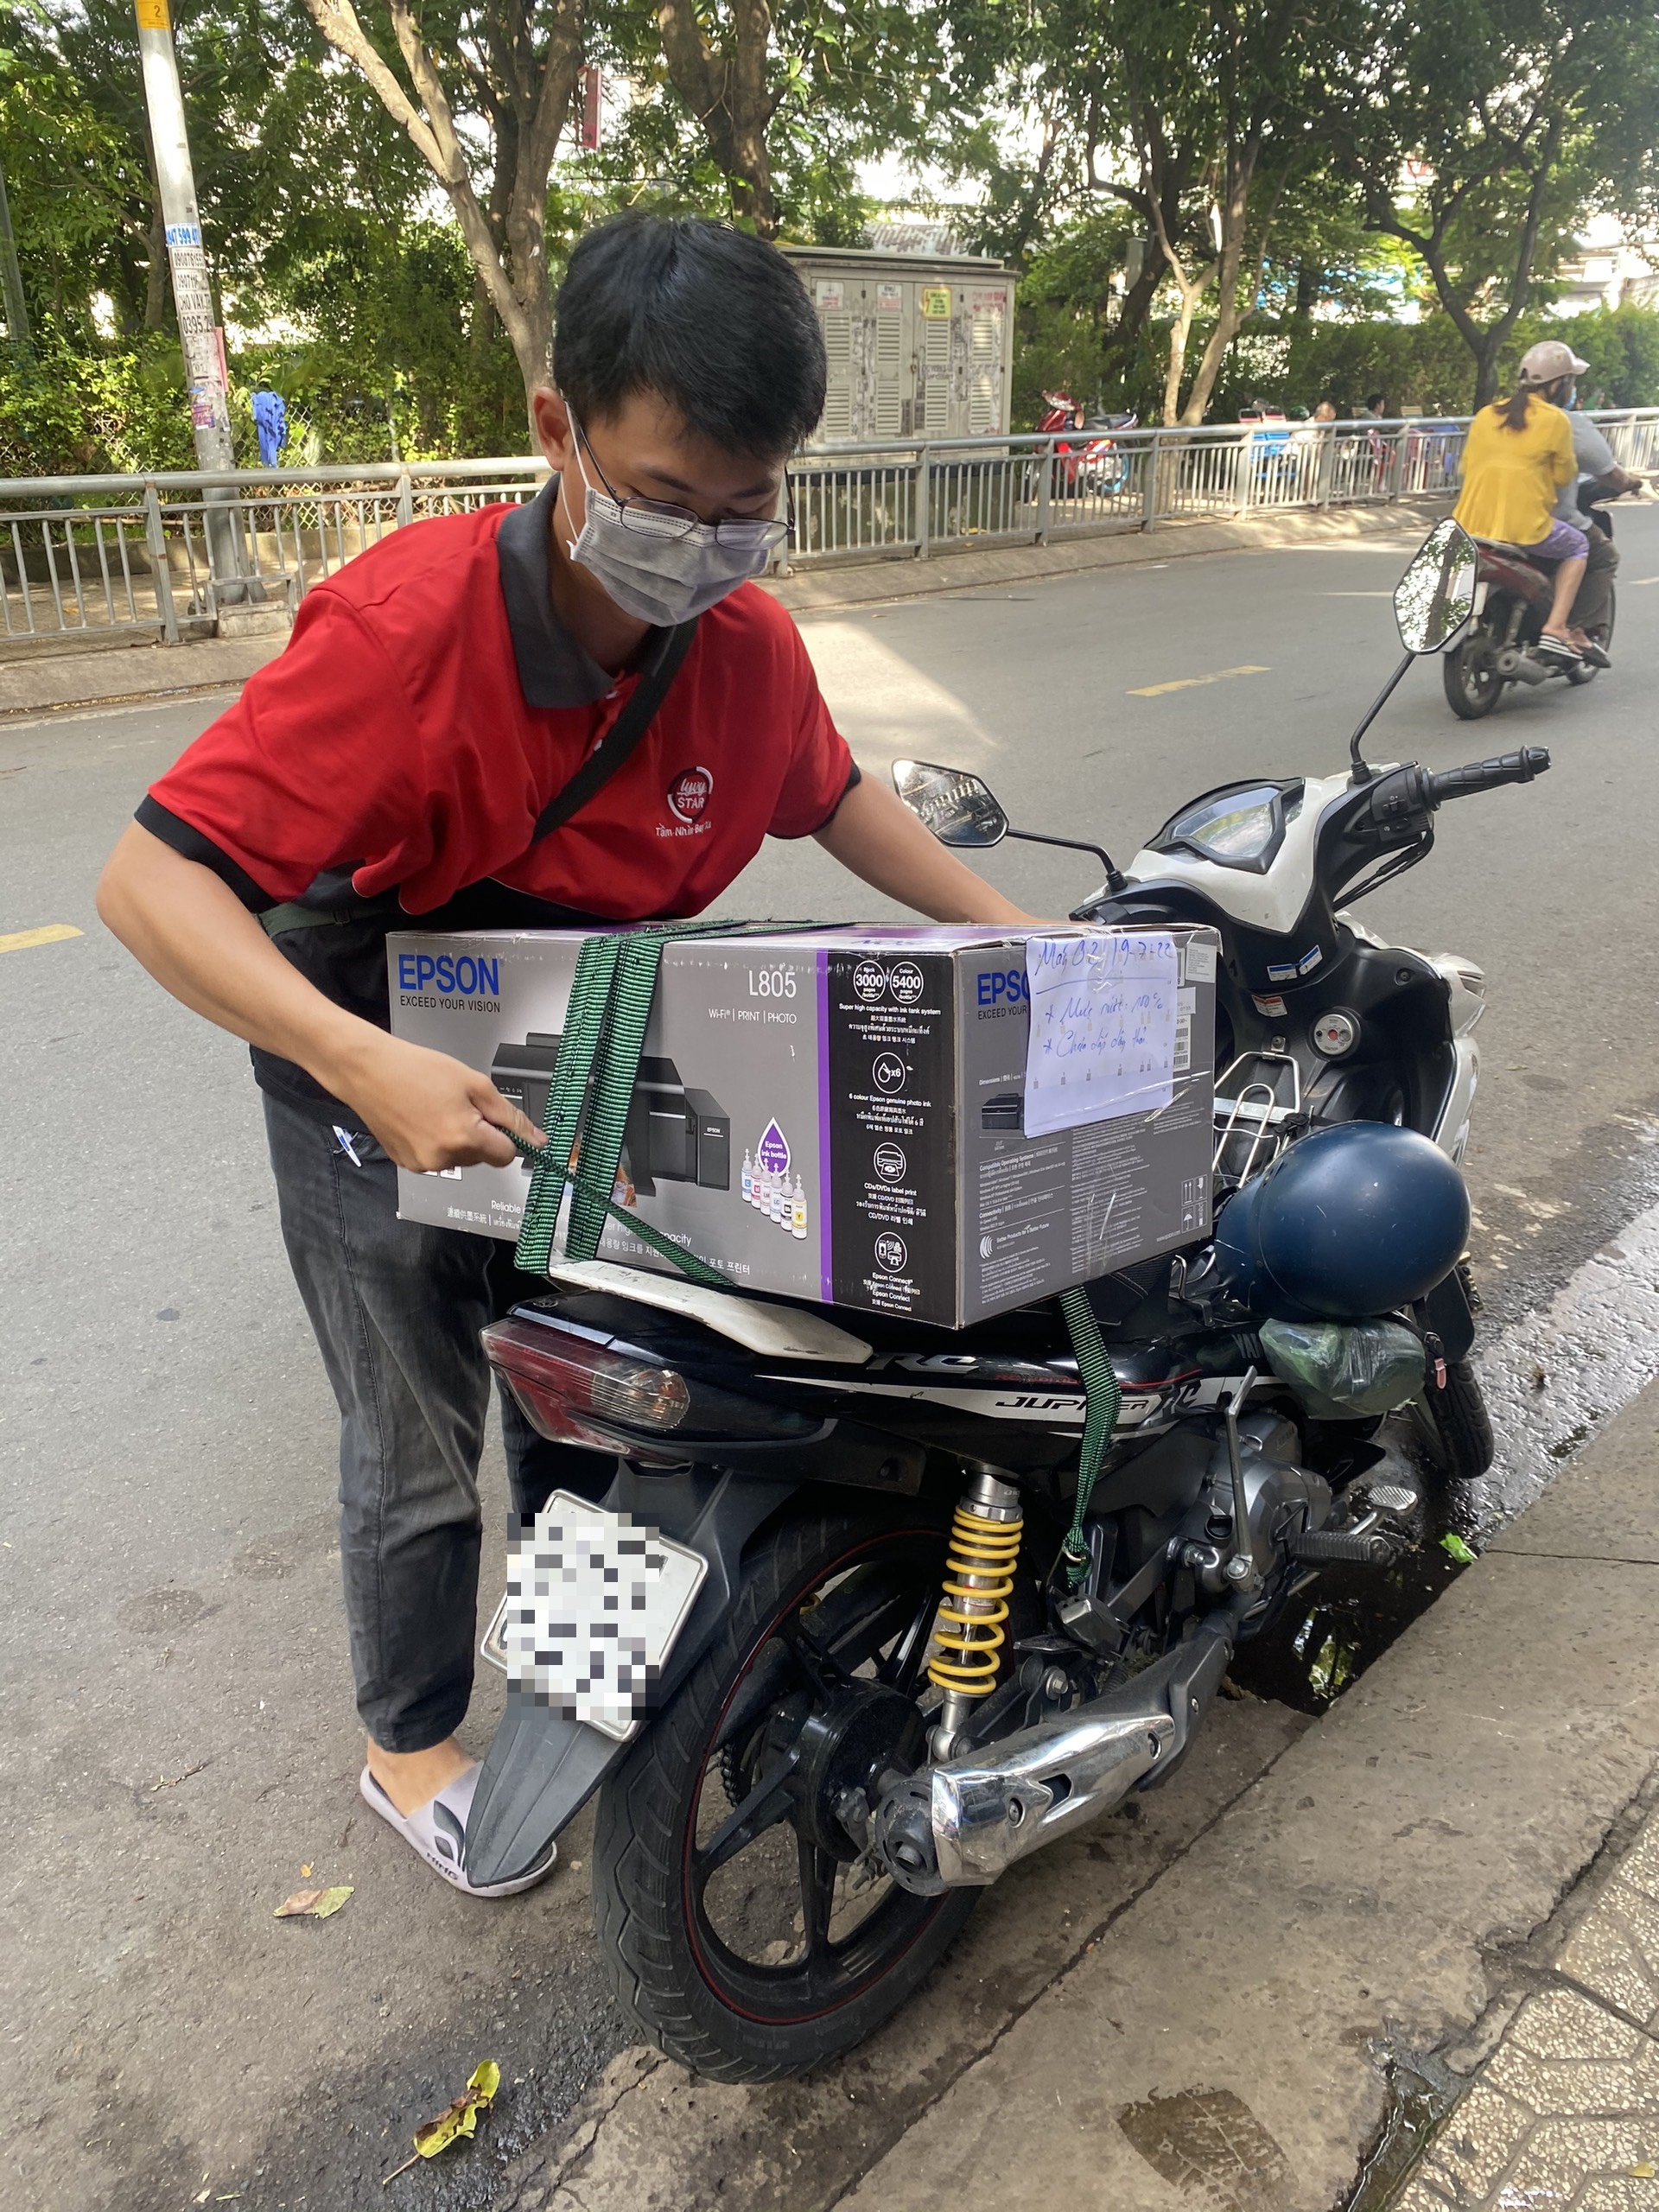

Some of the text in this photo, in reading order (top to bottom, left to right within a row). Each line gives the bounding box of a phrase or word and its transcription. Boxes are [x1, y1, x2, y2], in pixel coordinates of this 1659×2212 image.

[154, 4, 162, 18] 2
[677, 797, 705, 809] STAR
[398, 953, 500, 996] EPSON
[855, 974, 884, 988] 3000
[748, 969, 797, 998] L805
[892, 976, 921, 989] 5400
[400, 995, 500, 1014] EXCEED YOUR VISION
[838, 1002, 855, 1011] Super
[854, 1003, 866, 1013] high
[866, 1005, 887, 1014] capacity
[920, 1007, 941, 1016] system
[738, 1010, 760, 1022] PRINT
[767, 1012, 798, 1025] PHOTO
[977, 1004, 1028, 1020] EXCEED YOUR
[890, 1067, 901, 1077] x6
[869, 1095, 886, 1103] Epson
[906, 1099, 922, 1108] photo
[765, 1141, 784, 1150] Epson
[761, 1149, 787, 1160] ink bottle
[891, 1185, 904, 1194] label
[904, 1187, 917, 1197] print
[491, 1199, 522, 1215] Reliable
[709, 1255, 726, 1269] 포토
[727, 1261, 752, 1276] 프린터
[872, 1272, 888, 1282] Epson
[872, 1289, 888, 1300] Epson
